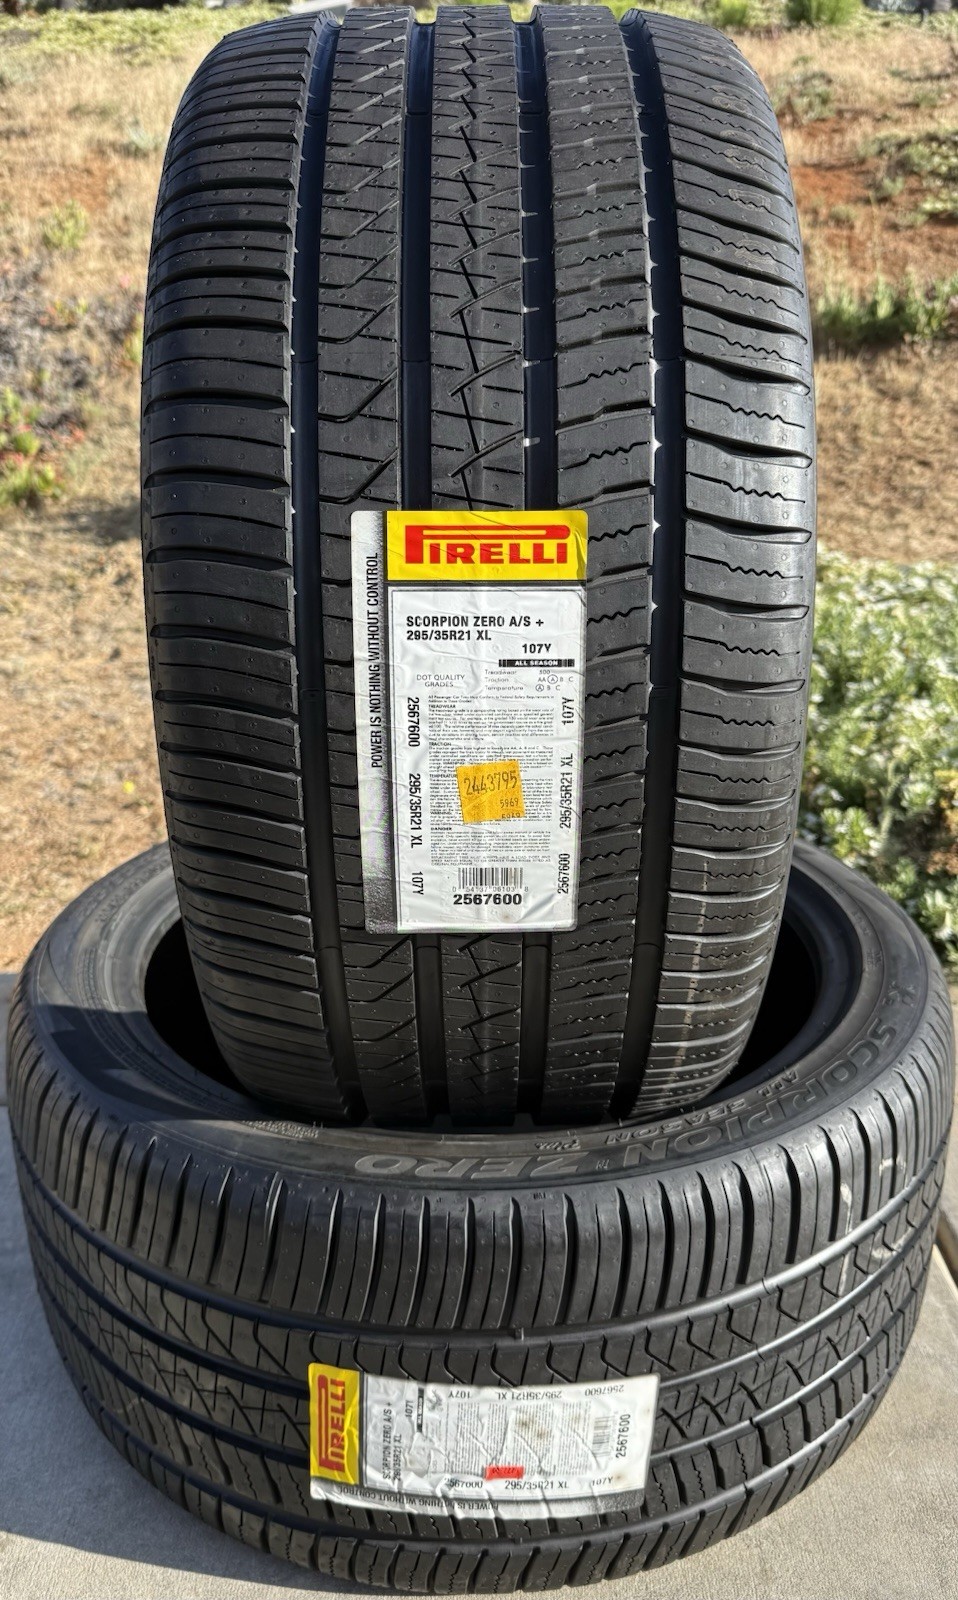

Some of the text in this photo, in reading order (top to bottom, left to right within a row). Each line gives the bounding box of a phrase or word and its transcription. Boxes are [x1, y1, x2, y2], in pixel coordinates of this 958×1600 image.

[405, 525, 571, 564] PIRELLI
[406, 616, 544, 627] SCORPION ZERO A/S +
[406, 630, 492, 641] 295/35R21 XL
[522, 643, 552, 654] 107Y
[366, 552, 383, 768] POWER IS NOTHING WITHOUT CONTROL
[434, 674, 466, 682] QUALITY
[407, 697, 421, 747] 2567600
[562, 696, 575, 725] 107Y
[463, 770, 518, 796] 2443795
[559, 752, 573, 829] 295/35R21 XL
[409, 773, 423, 848] 295/35R21 XL
[411, 871, 424, 896] 107Y
[557, 853, 571, 894] 2567600
[453, 893, 522, 905] 2567600
[622, 1018, 897, 1168] SCORPION
[756, 1068, 799, 1097] ALL
[604, 1098, 748, 1145] SEASON
[354, 1151, 590, 1180] ZERO
[448, 1390, 471, 1398] 107Y
[496, 1391, 562, 1400] 295/35R21 XL
[584, 1384, 625, 1397] 2567600
[317, 1374, 345, 1473] PIRELLI
[383, 1408, 392, 1423] A/S
[382, 1425, 392, 1445] ZERO
[392, 1433, 402, 1444] XL
[615, 1413, 631, 1459] 2567600
[558, 1480, 569, 1489] XL
